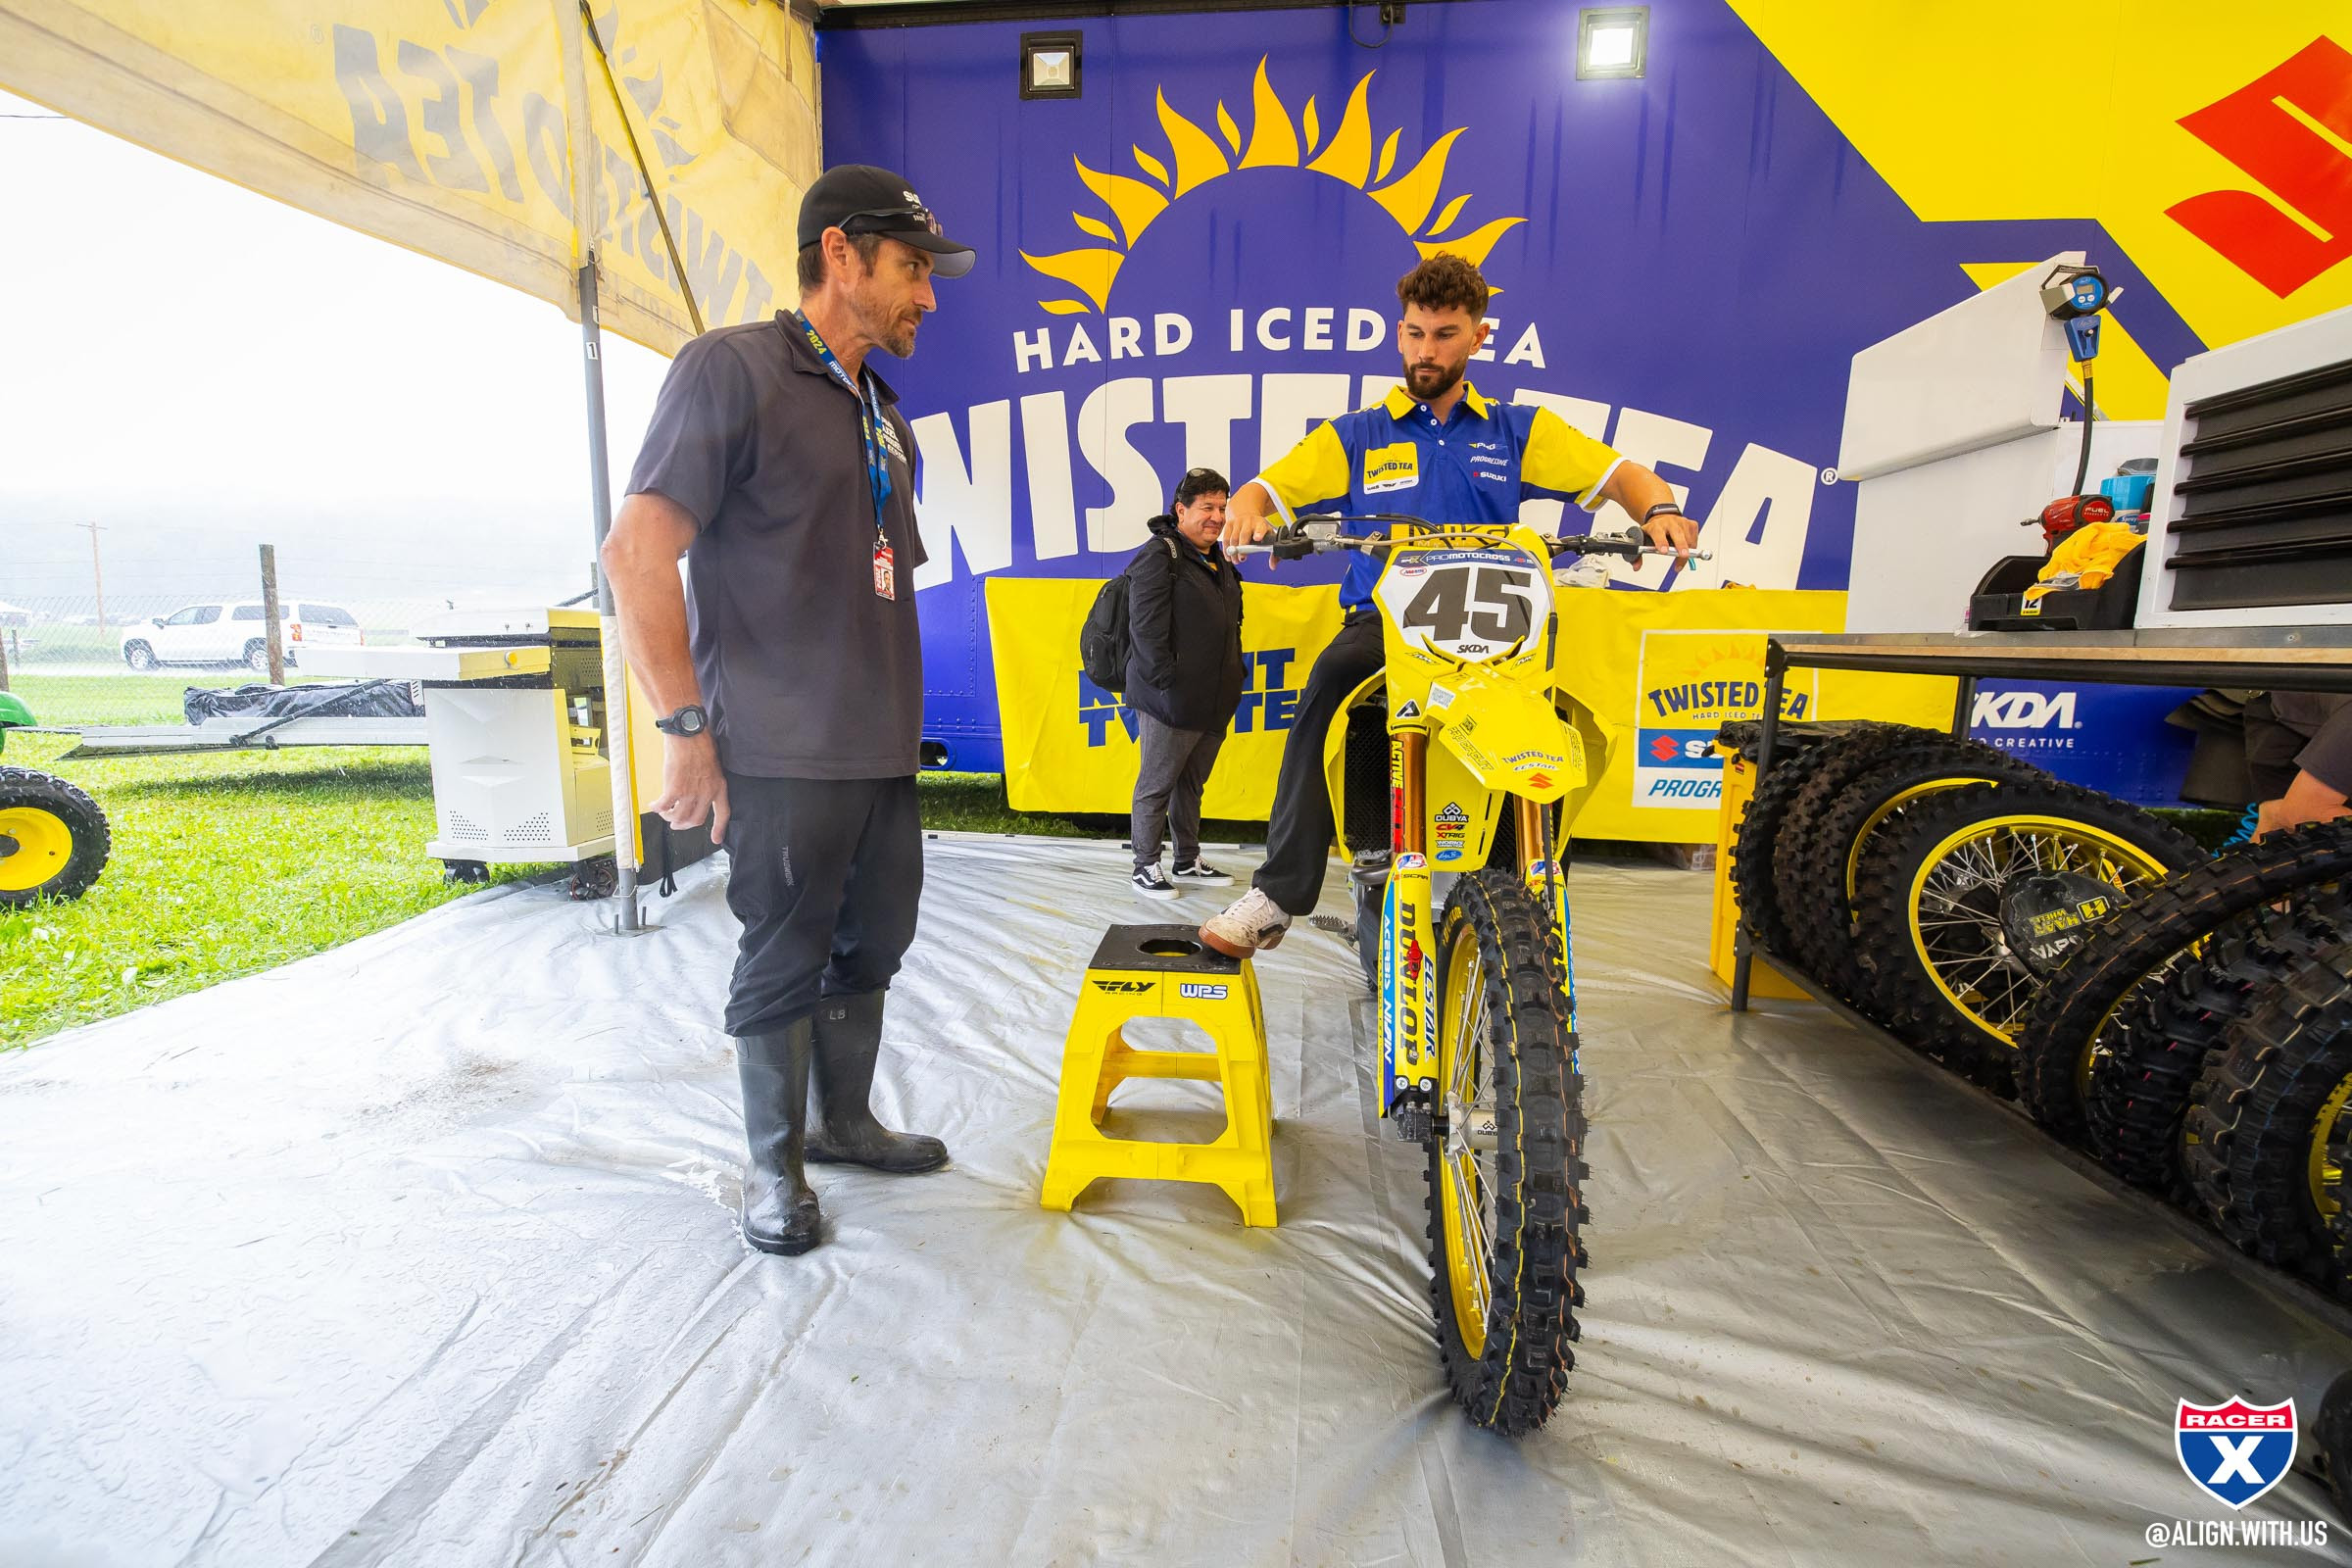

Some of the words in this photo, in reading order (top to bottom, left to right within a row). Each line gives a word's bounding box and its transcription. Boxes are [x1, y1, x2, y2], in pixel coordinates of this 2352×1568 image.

[806, 329, 827, 355] 2024
[1012, 313, 1193, 372] HARD
[1230, 307, 1387, 352] ICED
[1468, 317, 1546, 369] EA
[1367, 462, 1397, 479] TWISTED
[1398, 462, 1413, 470] TEA
[1470, 456, 1510, 466] PROGRESSIVE
[1480, 471, 1507, 482] SUZUKI
[1402, 566, 1533, 643] 45
[1647, 681, 1759, 717] TWISTED
[1971, 692, 2077, 729] KDA
[1502, 751, 1544, 762] TWISTED
[1545, 754, 1564, 762] TEA
[1994, 737, 2075, 748] CREATIVE
[1392, 740, 1404, 789] ACTIVE
[1180, 983, 1228, 1000] WPS
[1398, 899, 1419, 1066] DUNLOP
[1424, 954, 1437, 1060] ECSTAR
